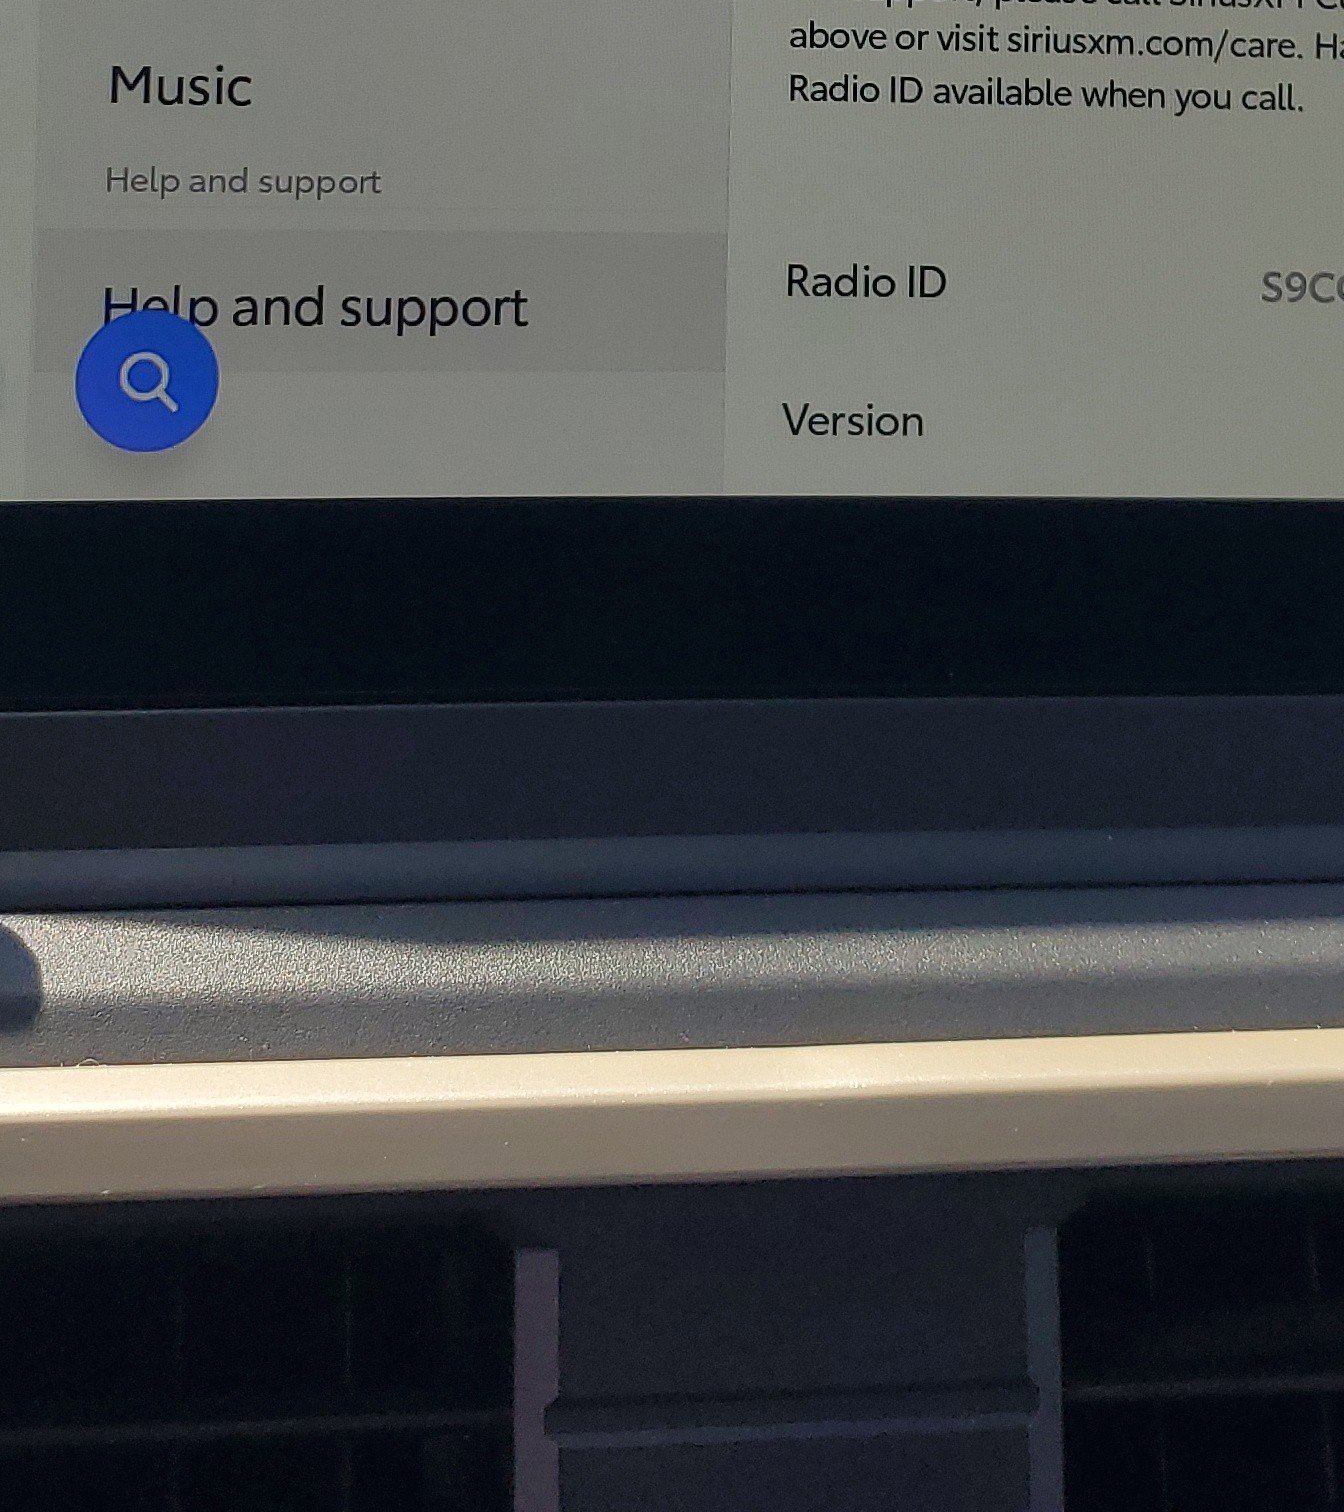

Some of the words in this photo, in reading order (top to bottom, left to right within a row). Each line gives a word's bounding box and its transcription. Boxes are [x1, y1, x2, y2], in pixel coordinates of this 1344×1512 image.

[789, 20, 888, 50] above
[894, 29, 930, 51] or
[936, 23, 1000, 53] visit
[1007, 24, 1303, 64] siriusxm.com/care.
[110, 64, 252, 107] Music
[789, 73, 881, 103] Radio
[889, 75, 924, 104] ID
[932, 76, 1073, 107] available
[1081, 79, 1166, 109] when
[1174, 88, 1232, 118] you
[1241, 82, 1304, 112] call.
[106, 165, 181, 200] Help
[188, 166, 249, 194] and
[258, 170, 382, 201] support
[787, 263, 897, 298] Radio
[908, 264, 947, 299] ID
[232, 284, 325, 327] and
[340, 289, 529, 337] support
[781, 402, 924, 437] Version
